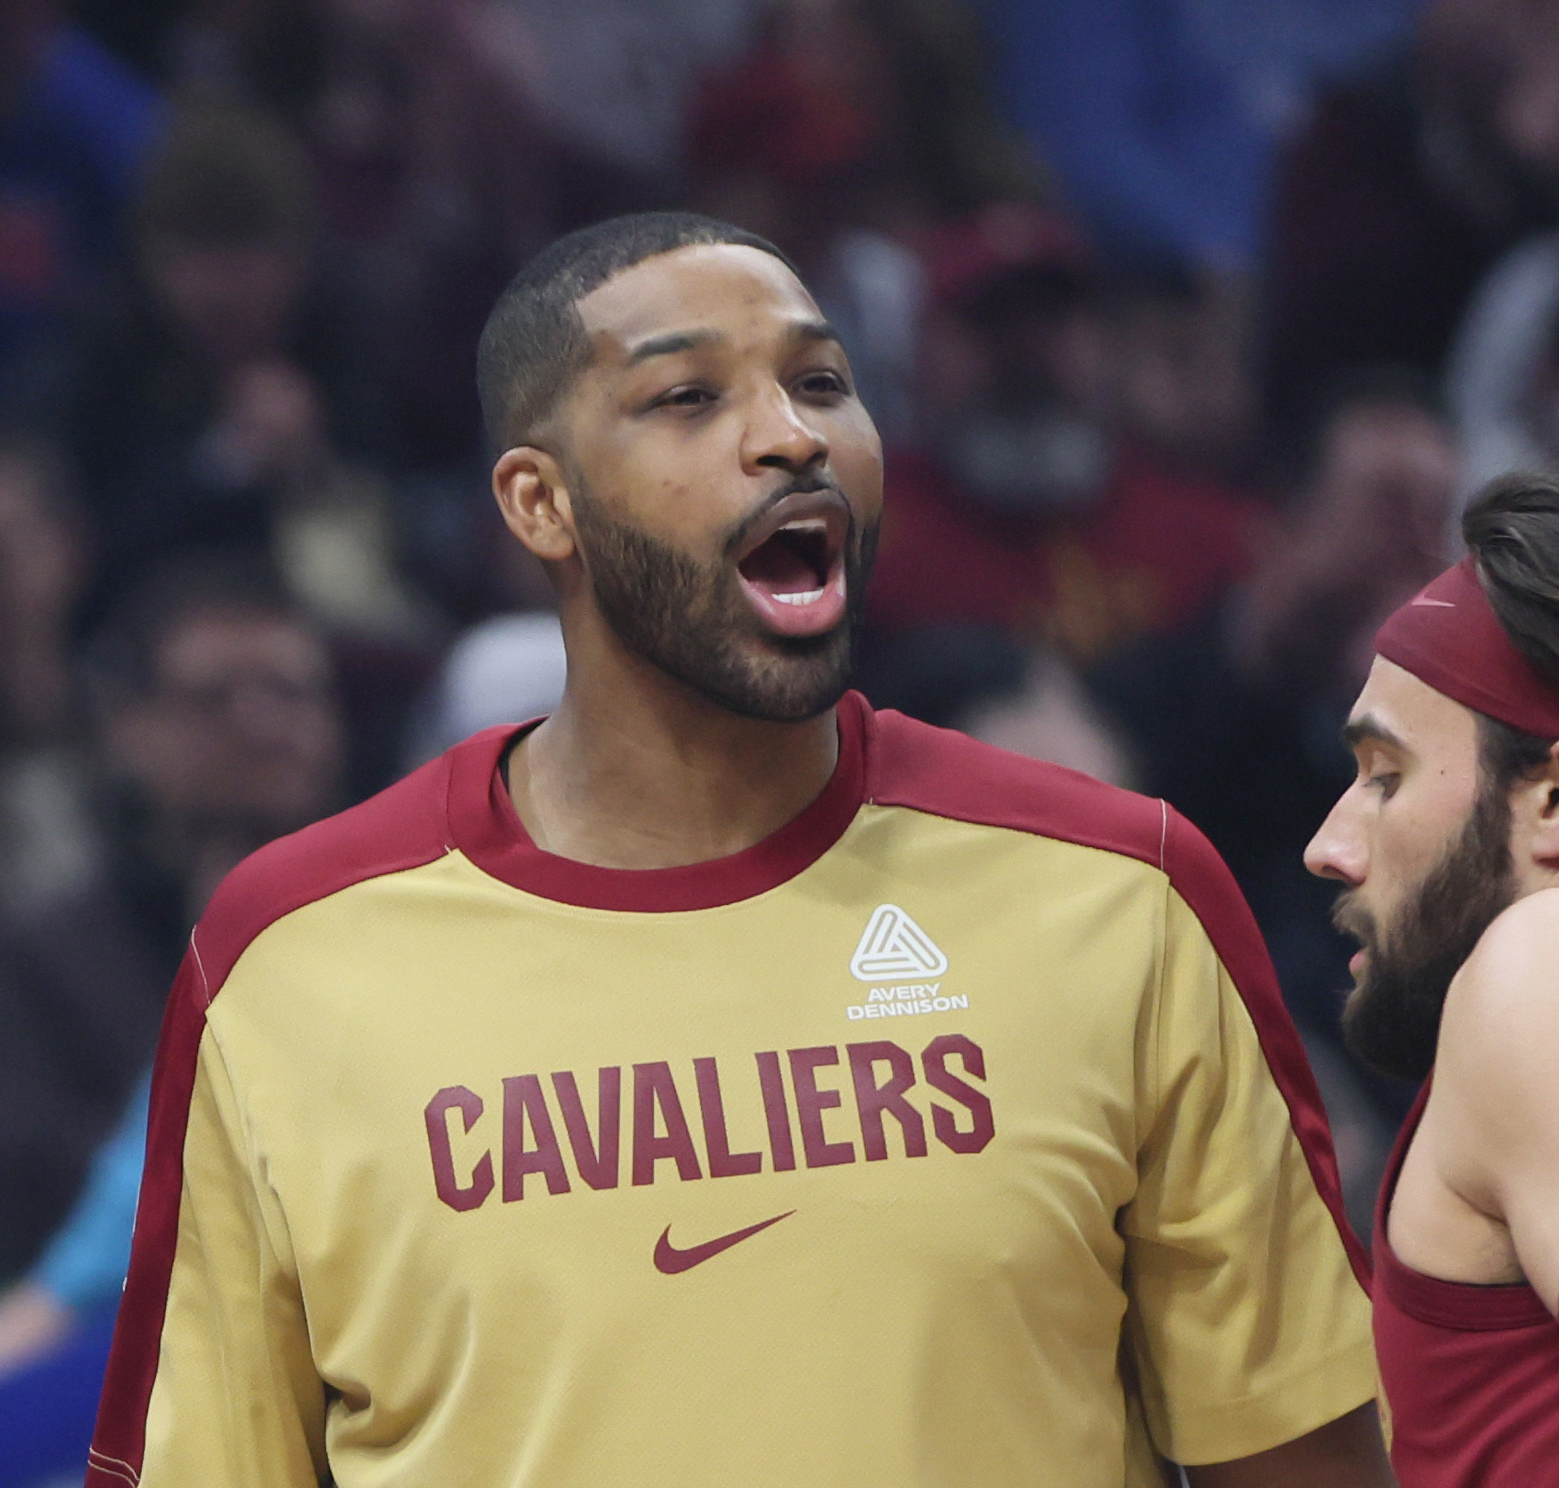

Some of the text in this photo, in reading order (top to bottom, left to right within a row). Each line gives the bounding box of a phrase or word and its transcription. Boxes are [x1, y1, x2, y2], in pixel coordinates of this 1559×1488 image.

[868, 982, 941, 1002] AVERY
[847, 994, 969, 1020] DENNISON
[424, 1033, 995, 1212] CAVALIERS
